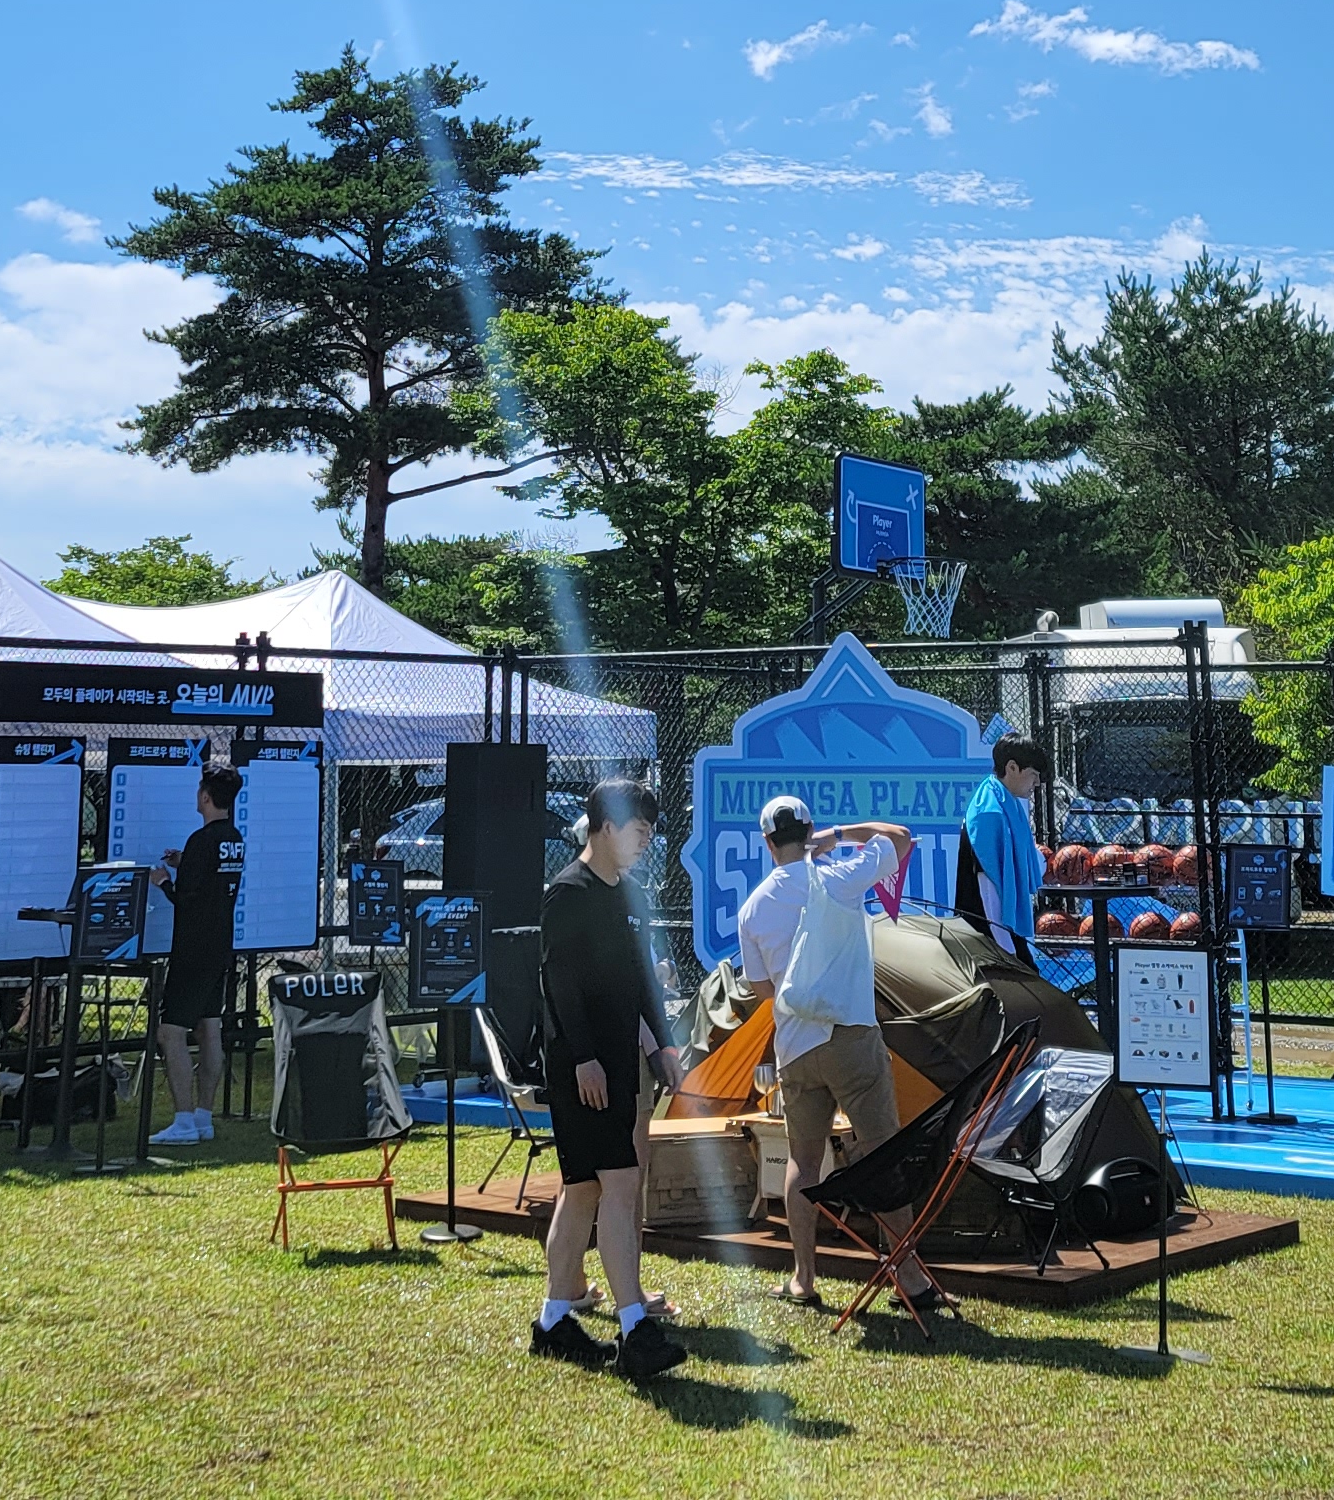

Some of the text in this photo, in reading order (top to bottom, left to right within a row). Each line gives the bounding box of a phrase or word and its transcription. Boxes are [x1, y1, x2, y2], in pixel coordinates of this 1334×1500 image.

[42, 687, 73, 703] 모두의
[75, 687, 114, 704] 플레이가
[116, 688, 155, 705] 시작되는
[174, 683, 224, 708] 오늘의
[229, 683, 275, 709] MVP
[128, 745, 168, 759] 프리드로우
[869, 780, 979, 816] PLAYE
